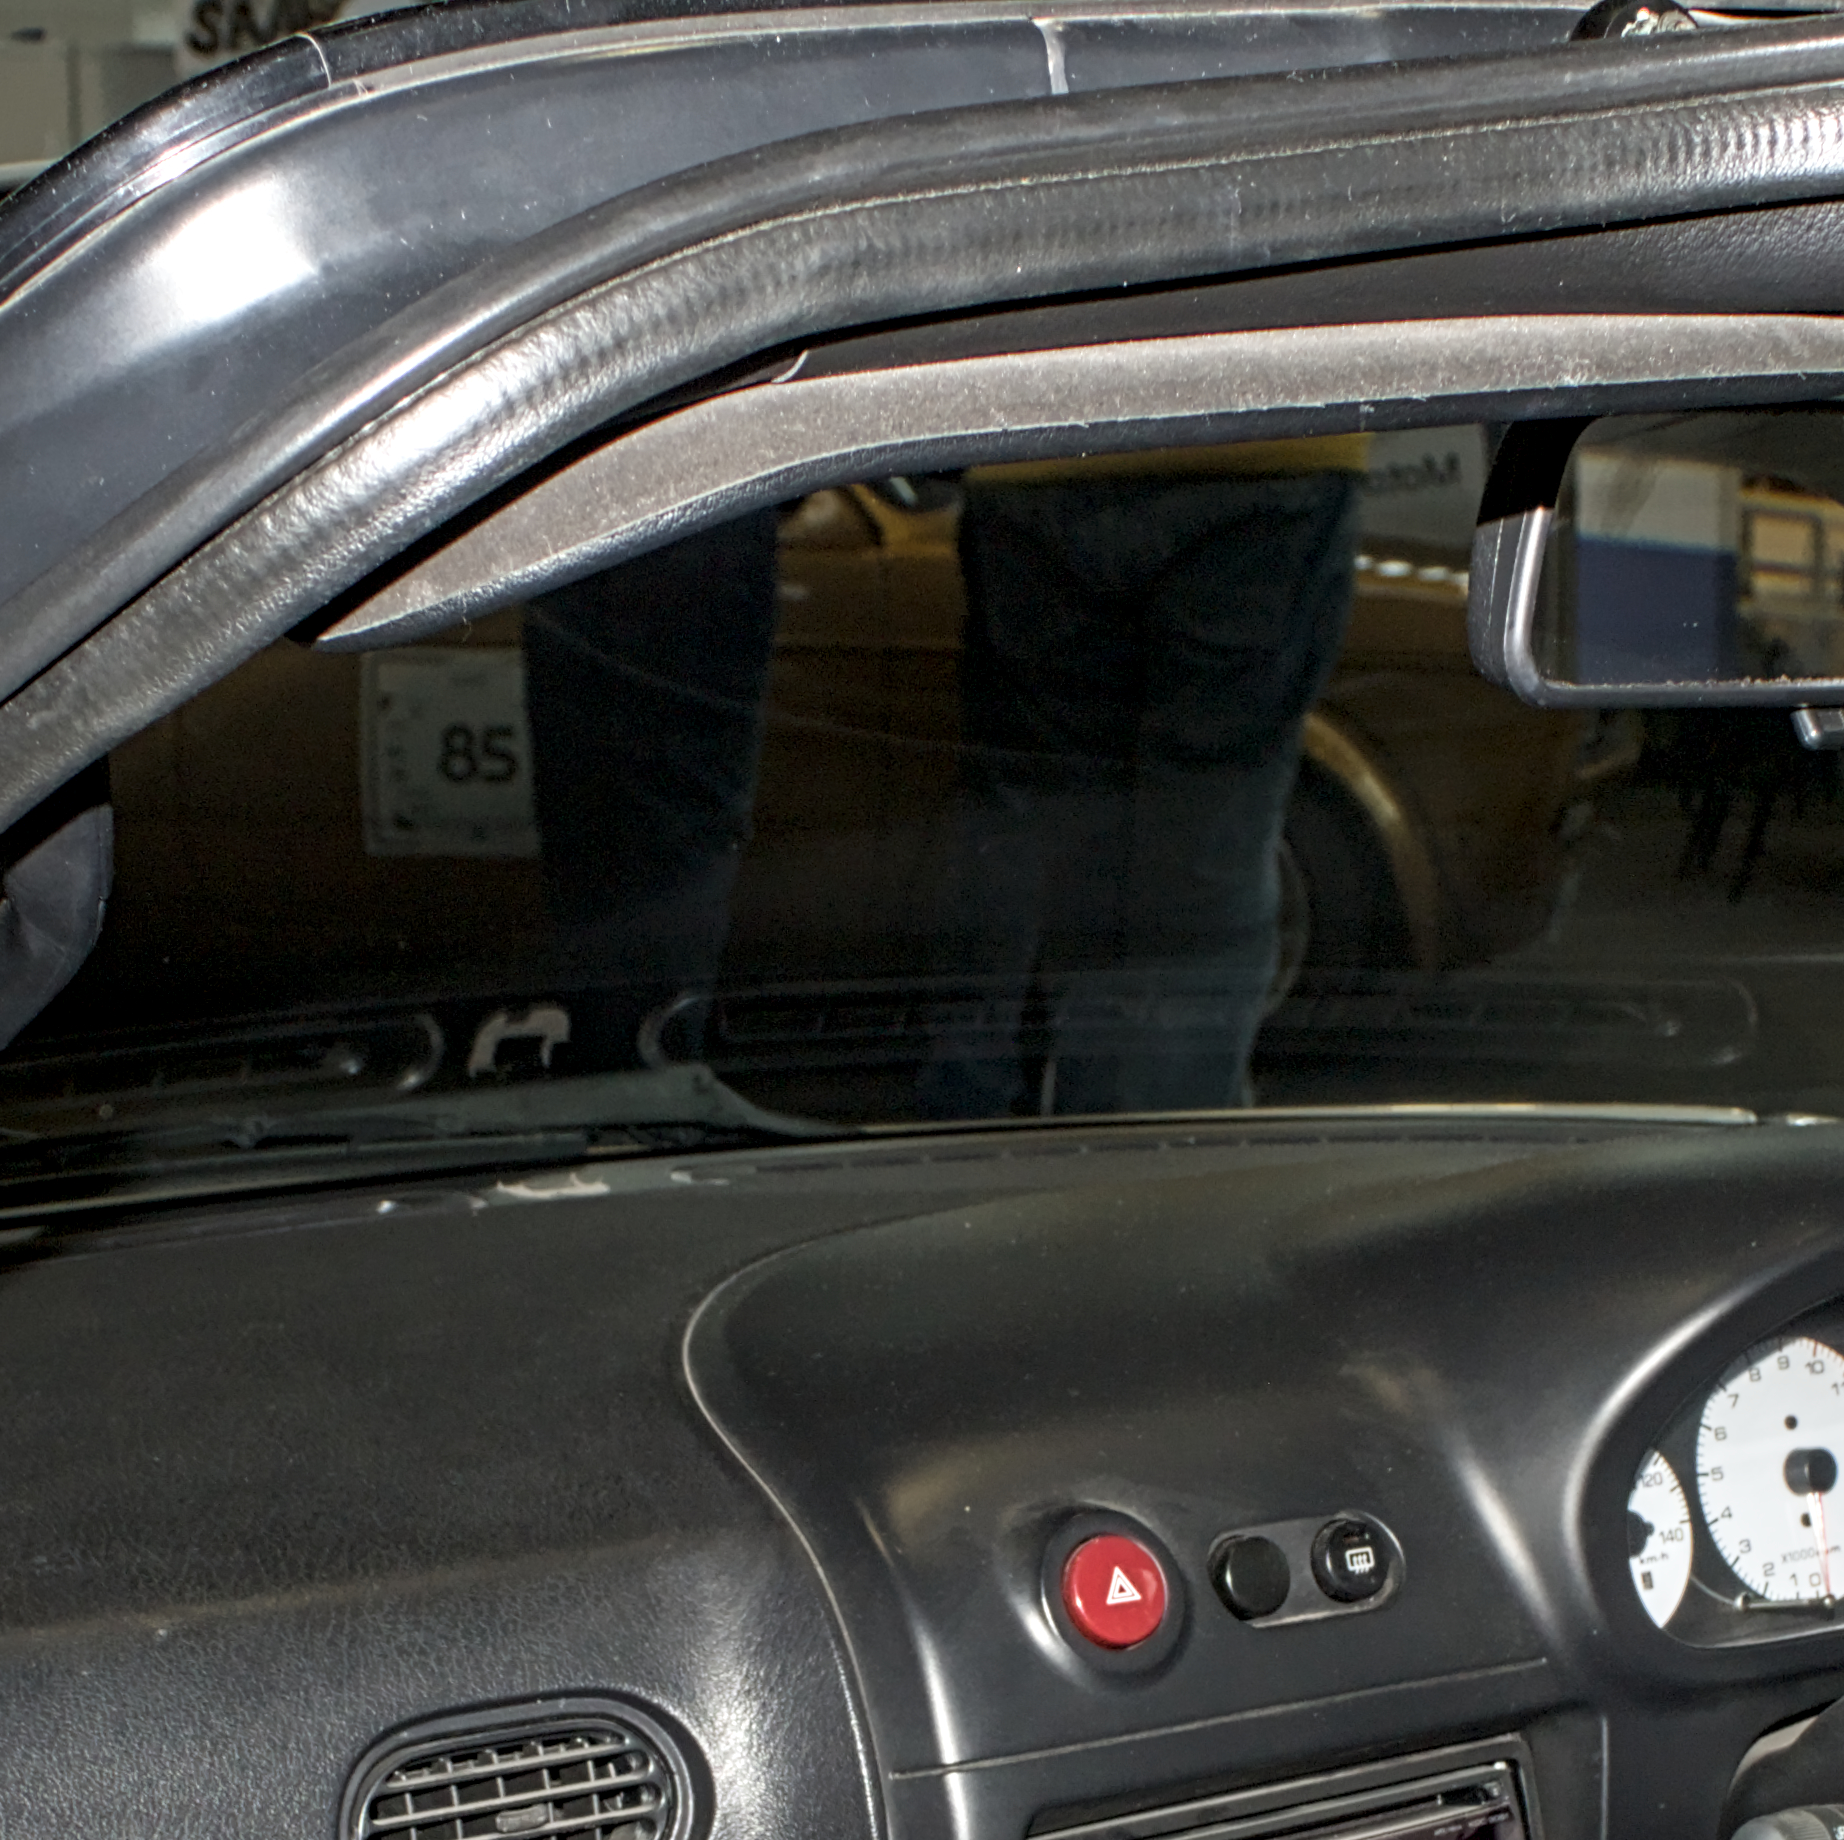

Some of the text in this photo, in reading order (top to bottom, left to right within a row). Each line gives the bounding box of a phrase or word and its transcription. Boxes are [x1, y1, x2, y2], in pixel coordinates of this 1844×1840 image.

[436, 721, 518, 784] 85
[1777, 1355, 1790, 1370] 9
[1805, 1360, 1825, 1375] 10
[1749, 1367, 1761, 1382] 8
[1728, 1393, 1739, 1408] 7
[1714, 1427, 1727, 1441] 6
[1711, 1467, 1724, 1481] 5
[1721, 1507, 1733, 1520] 4
[1659, 1527, 1684, 1544] 140
[1739, 1539, 1751, 1555] 3
[1762, 1561, 1775, 1577] 2
[1789, 1572, 1821, 1587] 1 0
